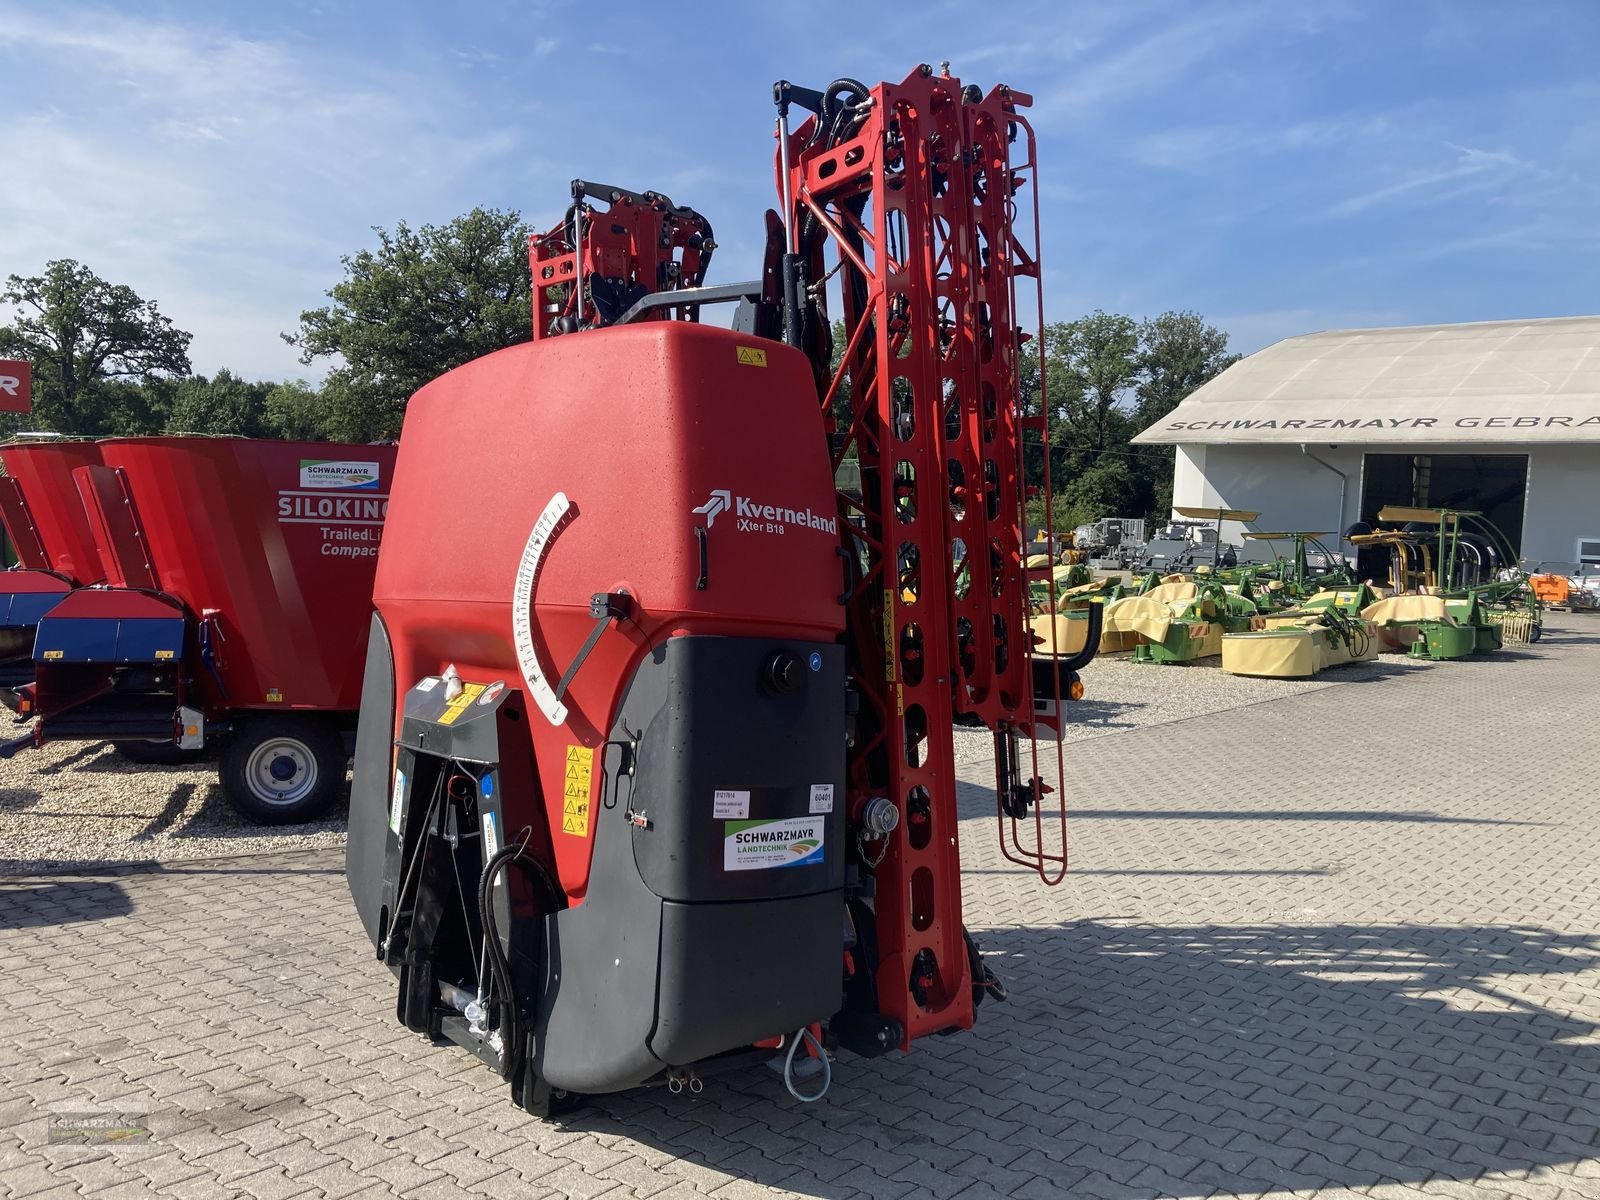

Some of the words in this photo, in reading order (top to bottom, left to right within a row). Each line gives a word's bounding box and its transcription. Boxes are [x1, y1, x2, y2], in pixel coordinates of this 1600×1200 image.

[1166, 417, 1439, 431] SCHWARZMAYR
[307, 466, 369, 475] SCHWARZMAYR
[736, 496, 837, 536] Kverneland
[320, 527, 380, 541] TrailedLi
[737, 519, 764, 532] iXter
[766, 523, 785, 535] B18
[320, 543, 380, 559] Compac
[735, 828, 814, 844] SCHWARZMAYR
[737, 844, 788, 853] LANDTECHNIK
